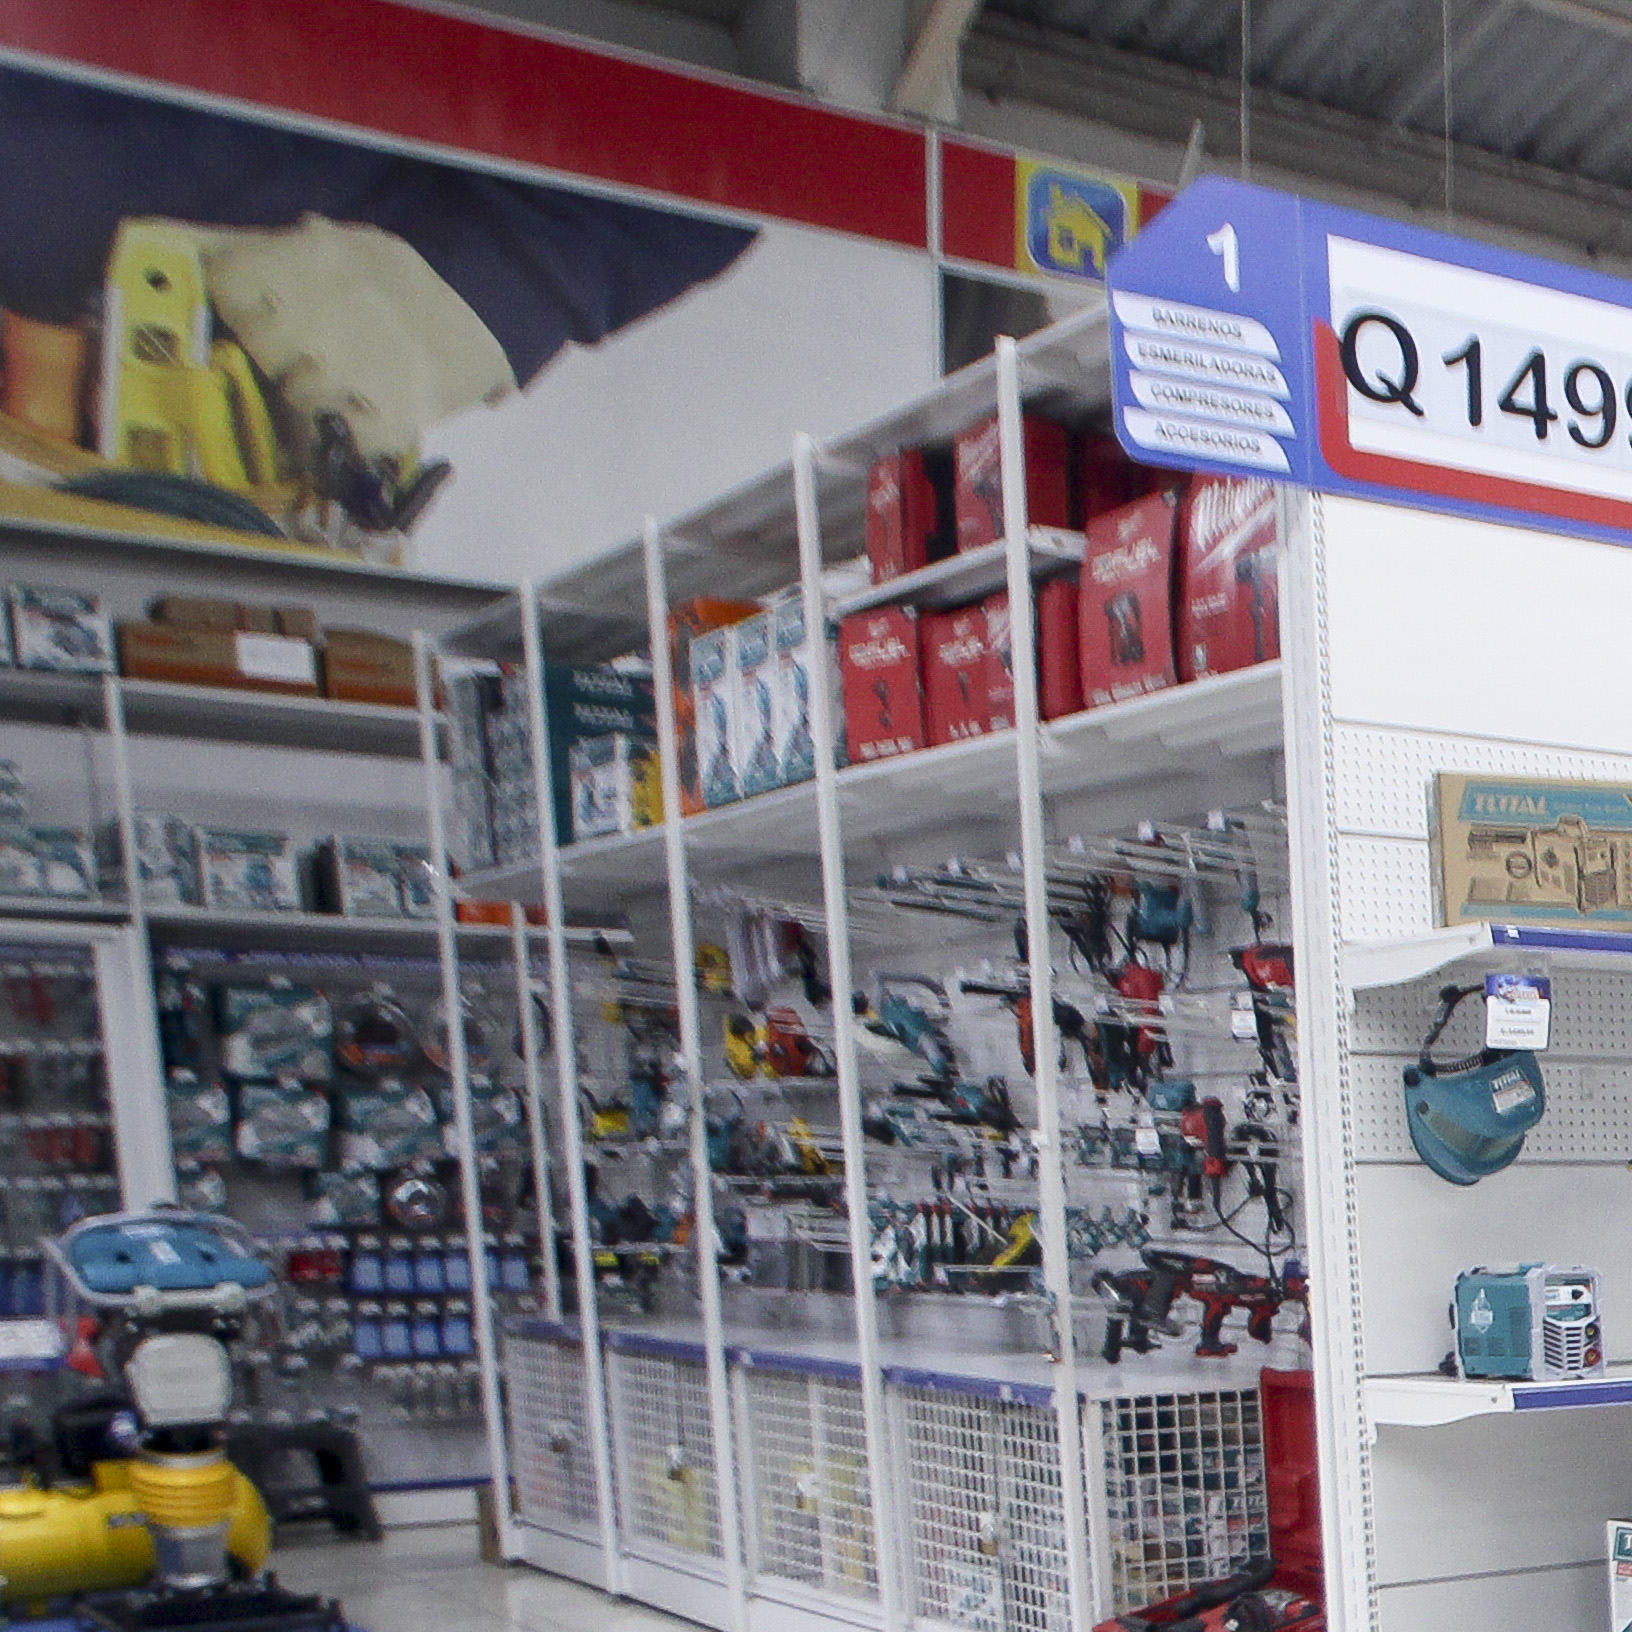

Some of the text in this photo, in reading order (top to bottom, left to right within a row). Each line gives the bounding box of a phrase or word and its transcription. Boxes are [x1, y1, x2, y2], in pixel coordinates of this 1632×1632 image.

[1206, 221, 1241, 293] 1
[1152, 306, 1242, 338] BARRENOS
[1137, 341, 1276, 382] ESMERILADORAS
[1151, 382, 1274, 418] COMPRESORES
[1154, 421, 1261, 453] ACCESORIOS
[1474, 792, 1547, 815] TOTAL
